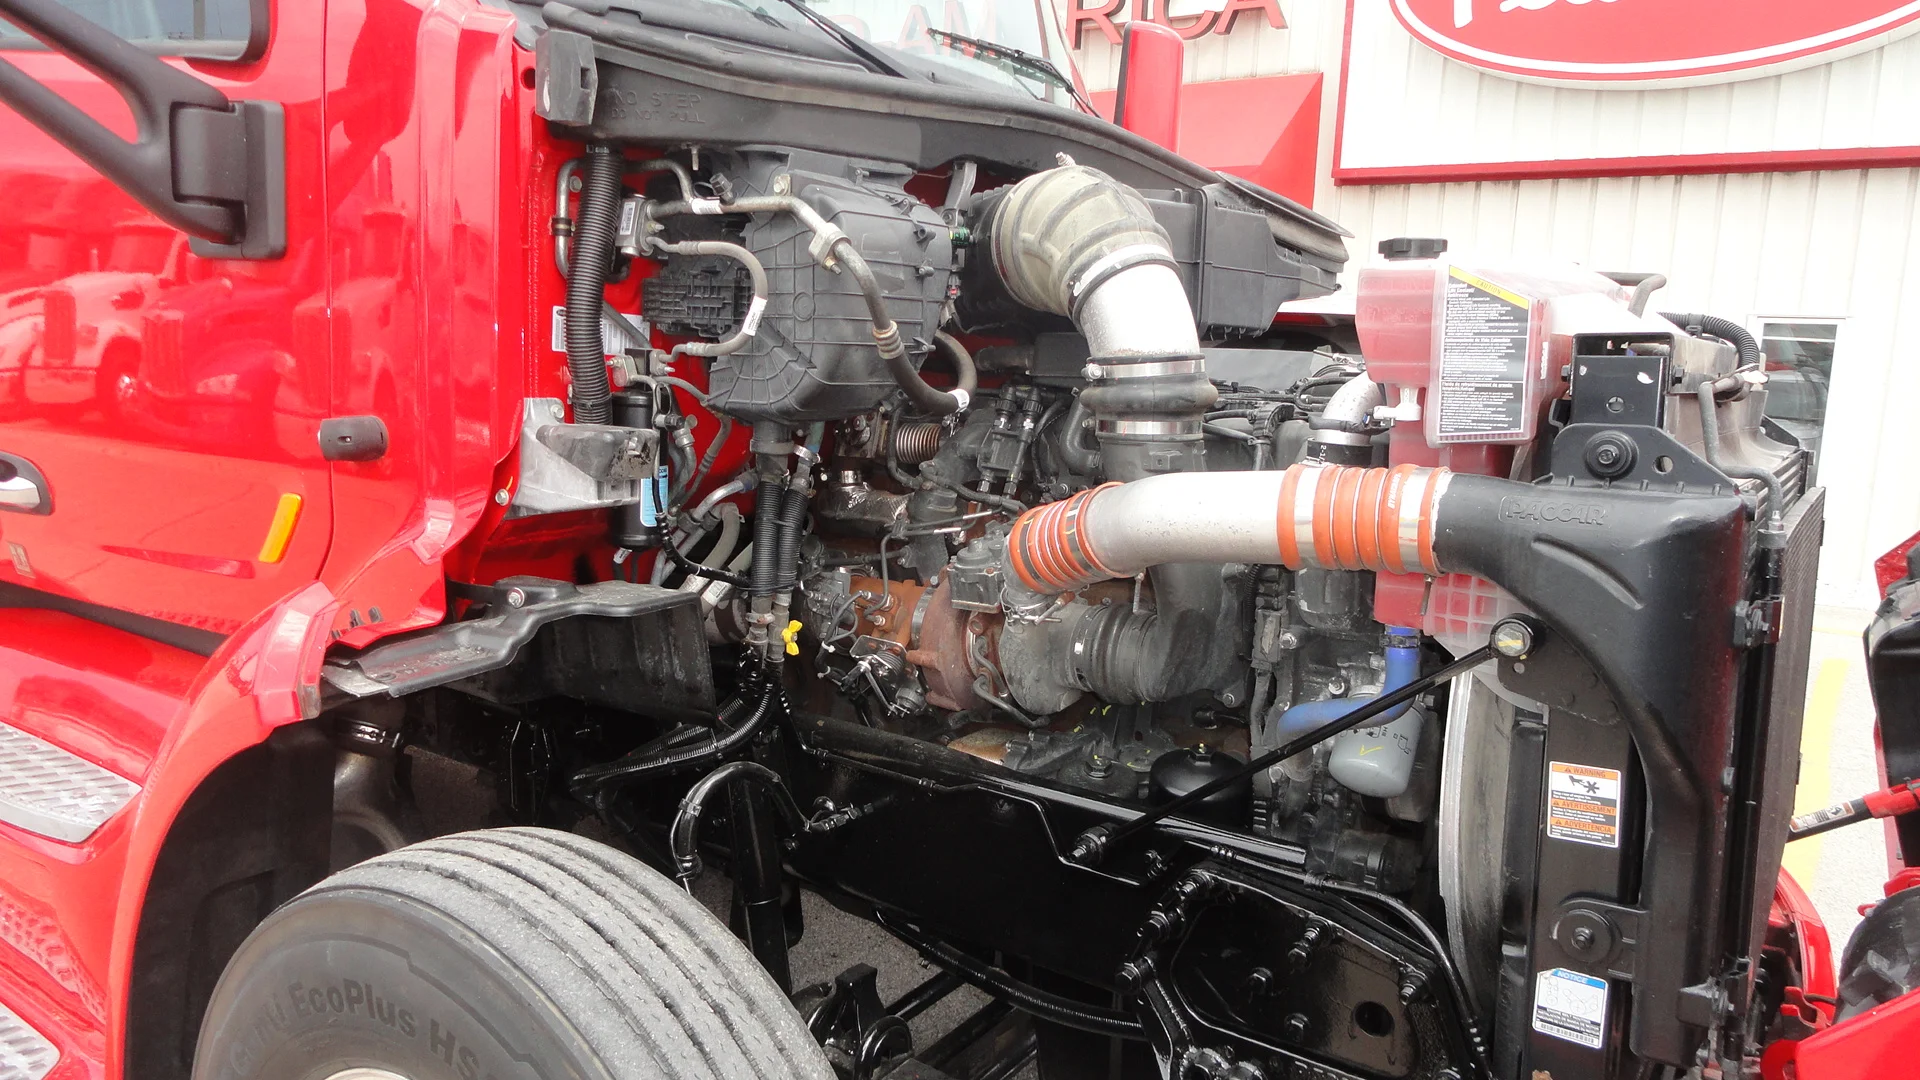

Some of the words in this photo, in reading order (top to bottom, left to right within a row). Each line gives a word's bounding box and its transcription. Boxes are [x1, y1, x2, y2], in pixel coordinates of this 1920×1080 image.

[609, 86, 638, 106] NO
[651, 91, 702, 109] STEP
[1475, 279, 1501, 295] CAUTION
[1506, 500, 1606, 526] PACCAR
[1573, 766, 1606, 778] WARNING
[1562, 801, 1615, 814] AVERTISSEMENT
[1565, 820, 1611, 833] ADVERTENCIA
[1557, 970, 1588, 983] NOTICE
[287, 977, 417, 1038] EcoPlus
[429, 1018, 498, 1080] HS
